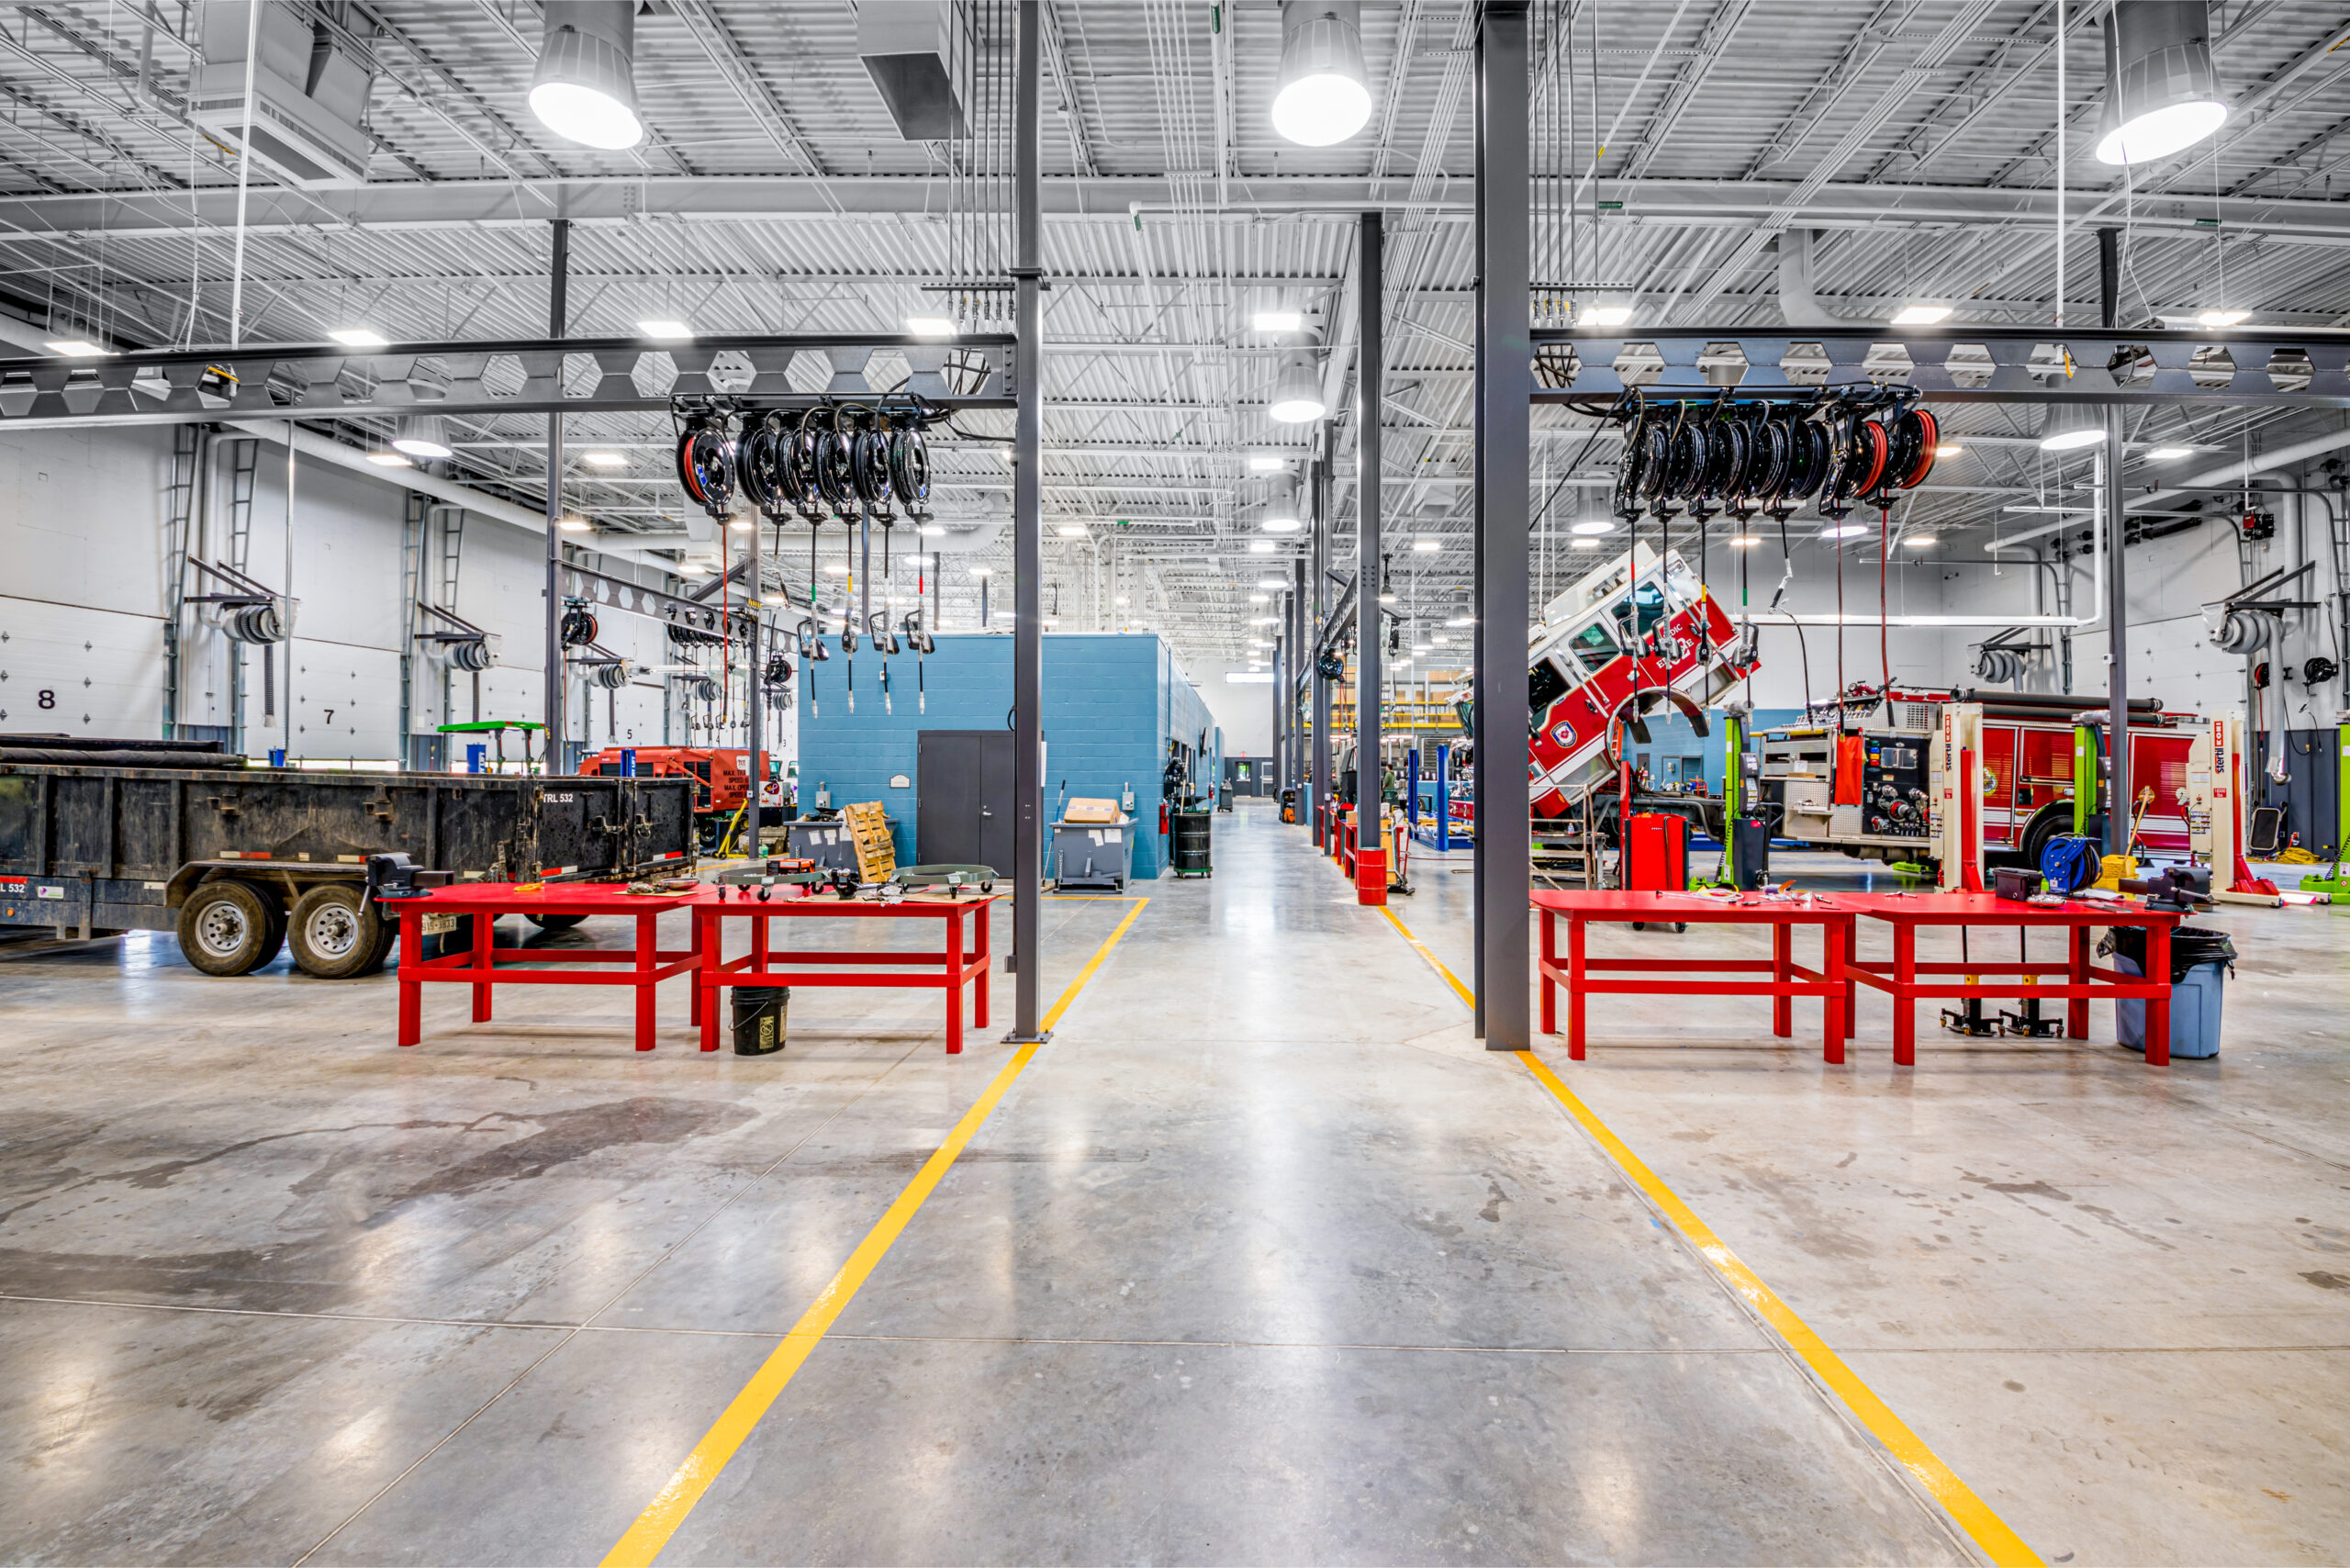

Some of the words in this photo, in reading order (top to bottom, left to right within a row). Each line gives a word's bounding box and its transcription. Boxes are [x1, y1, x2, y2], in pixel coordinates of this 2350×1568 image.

[38, 689, 55, 710] 8
[324, 709, 334, 724] 7
[627, 729, 632, 739] 5
[2214, 721, 2223, 747] KONI
[2215, 747, 2224, 774] stertil
[559, 793, 574, 802] 532
[8, 884, 25, 893] 532
